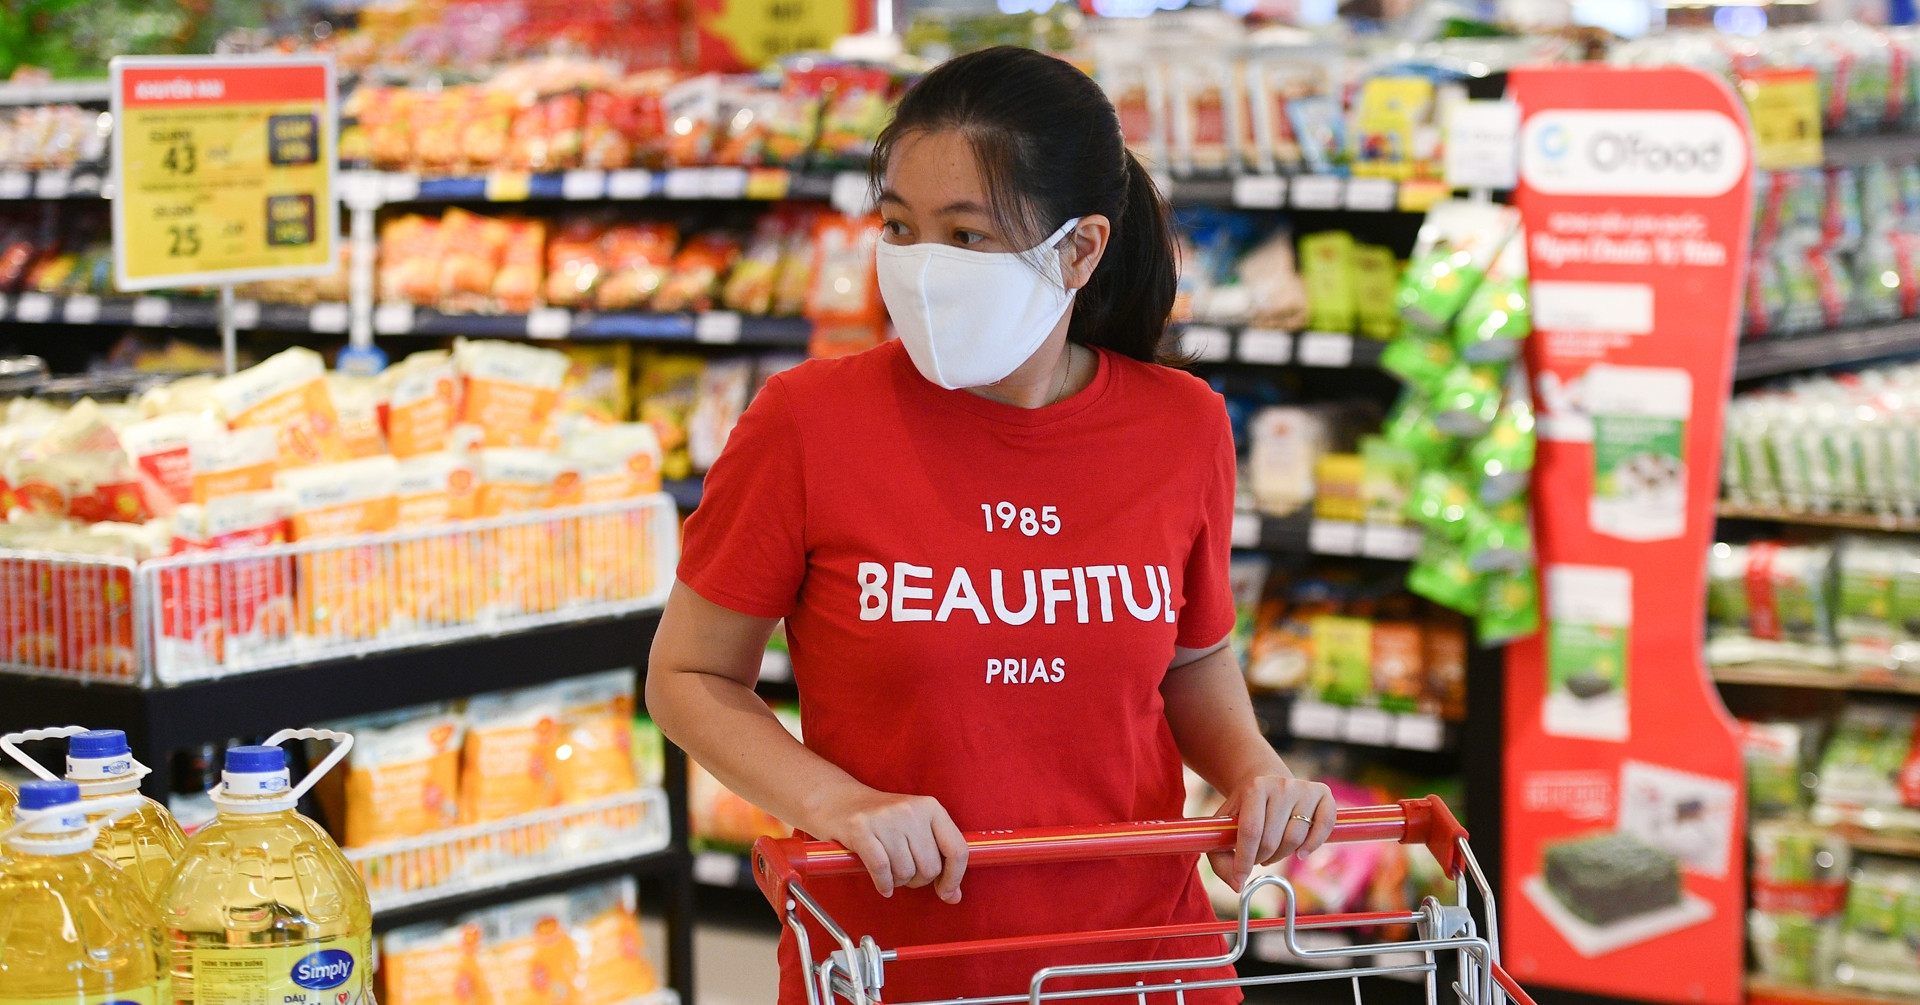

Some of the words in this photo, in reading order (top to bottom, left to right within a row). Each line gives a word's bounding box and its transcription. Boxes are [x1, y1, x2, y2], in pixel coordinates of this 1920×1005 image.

[164, 144, 196, 174] 43
[169, 227, 201, 256] 25
[981, 501, 1061, 536] 1985
[857, 562, 1176, 625] BEAUFITUL
[985, 658, 1065, 684] PRIAS
[298, 959, 351, 980] Simply
